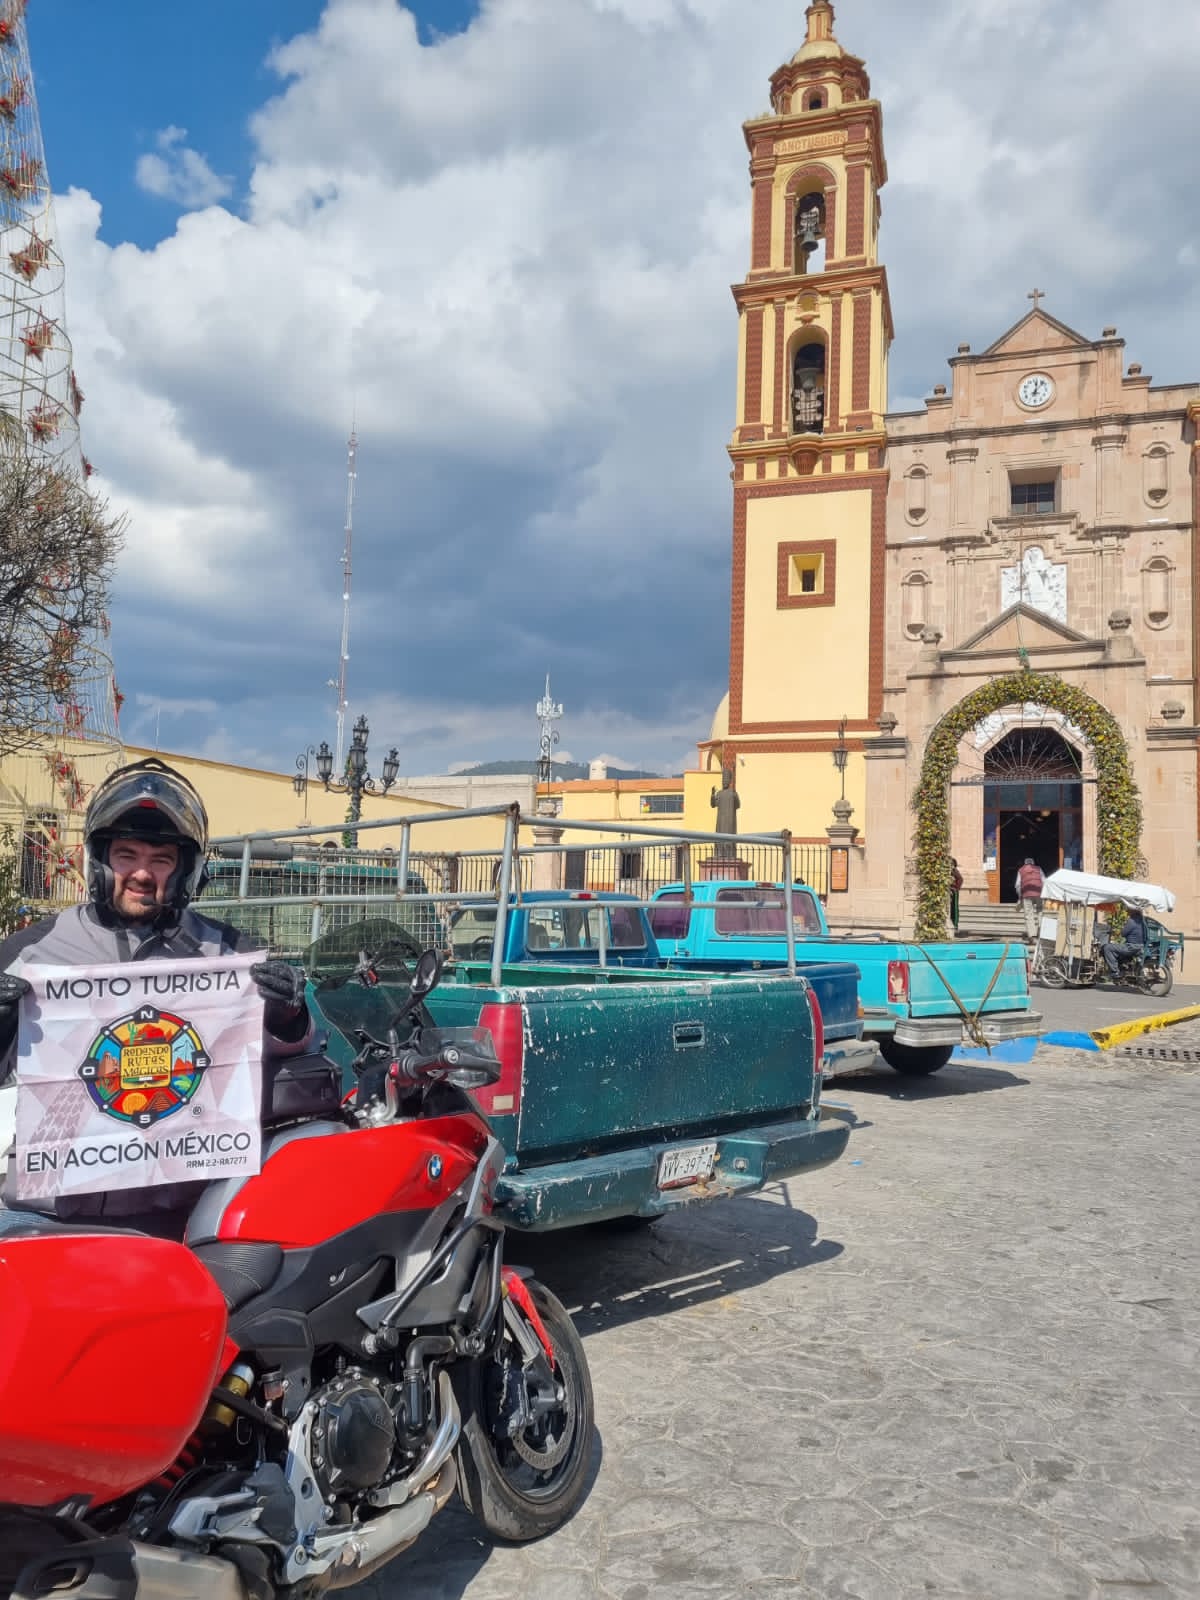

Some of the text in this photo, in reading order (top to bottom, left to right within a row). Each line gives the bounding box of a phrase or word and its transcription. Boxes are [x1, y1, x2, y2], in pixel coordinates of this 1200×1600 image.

[46, 970, 240, 1000] MOTO TURISTA
[140, 1010, 153, 1020] N
[196, 1058, 207, 1067] E
[83, 1066, 95, 1076] O
[140, 1115, 151, 1123] S
[26, 1131, 250, 1172] EN ACCIÓN MÉXICO
